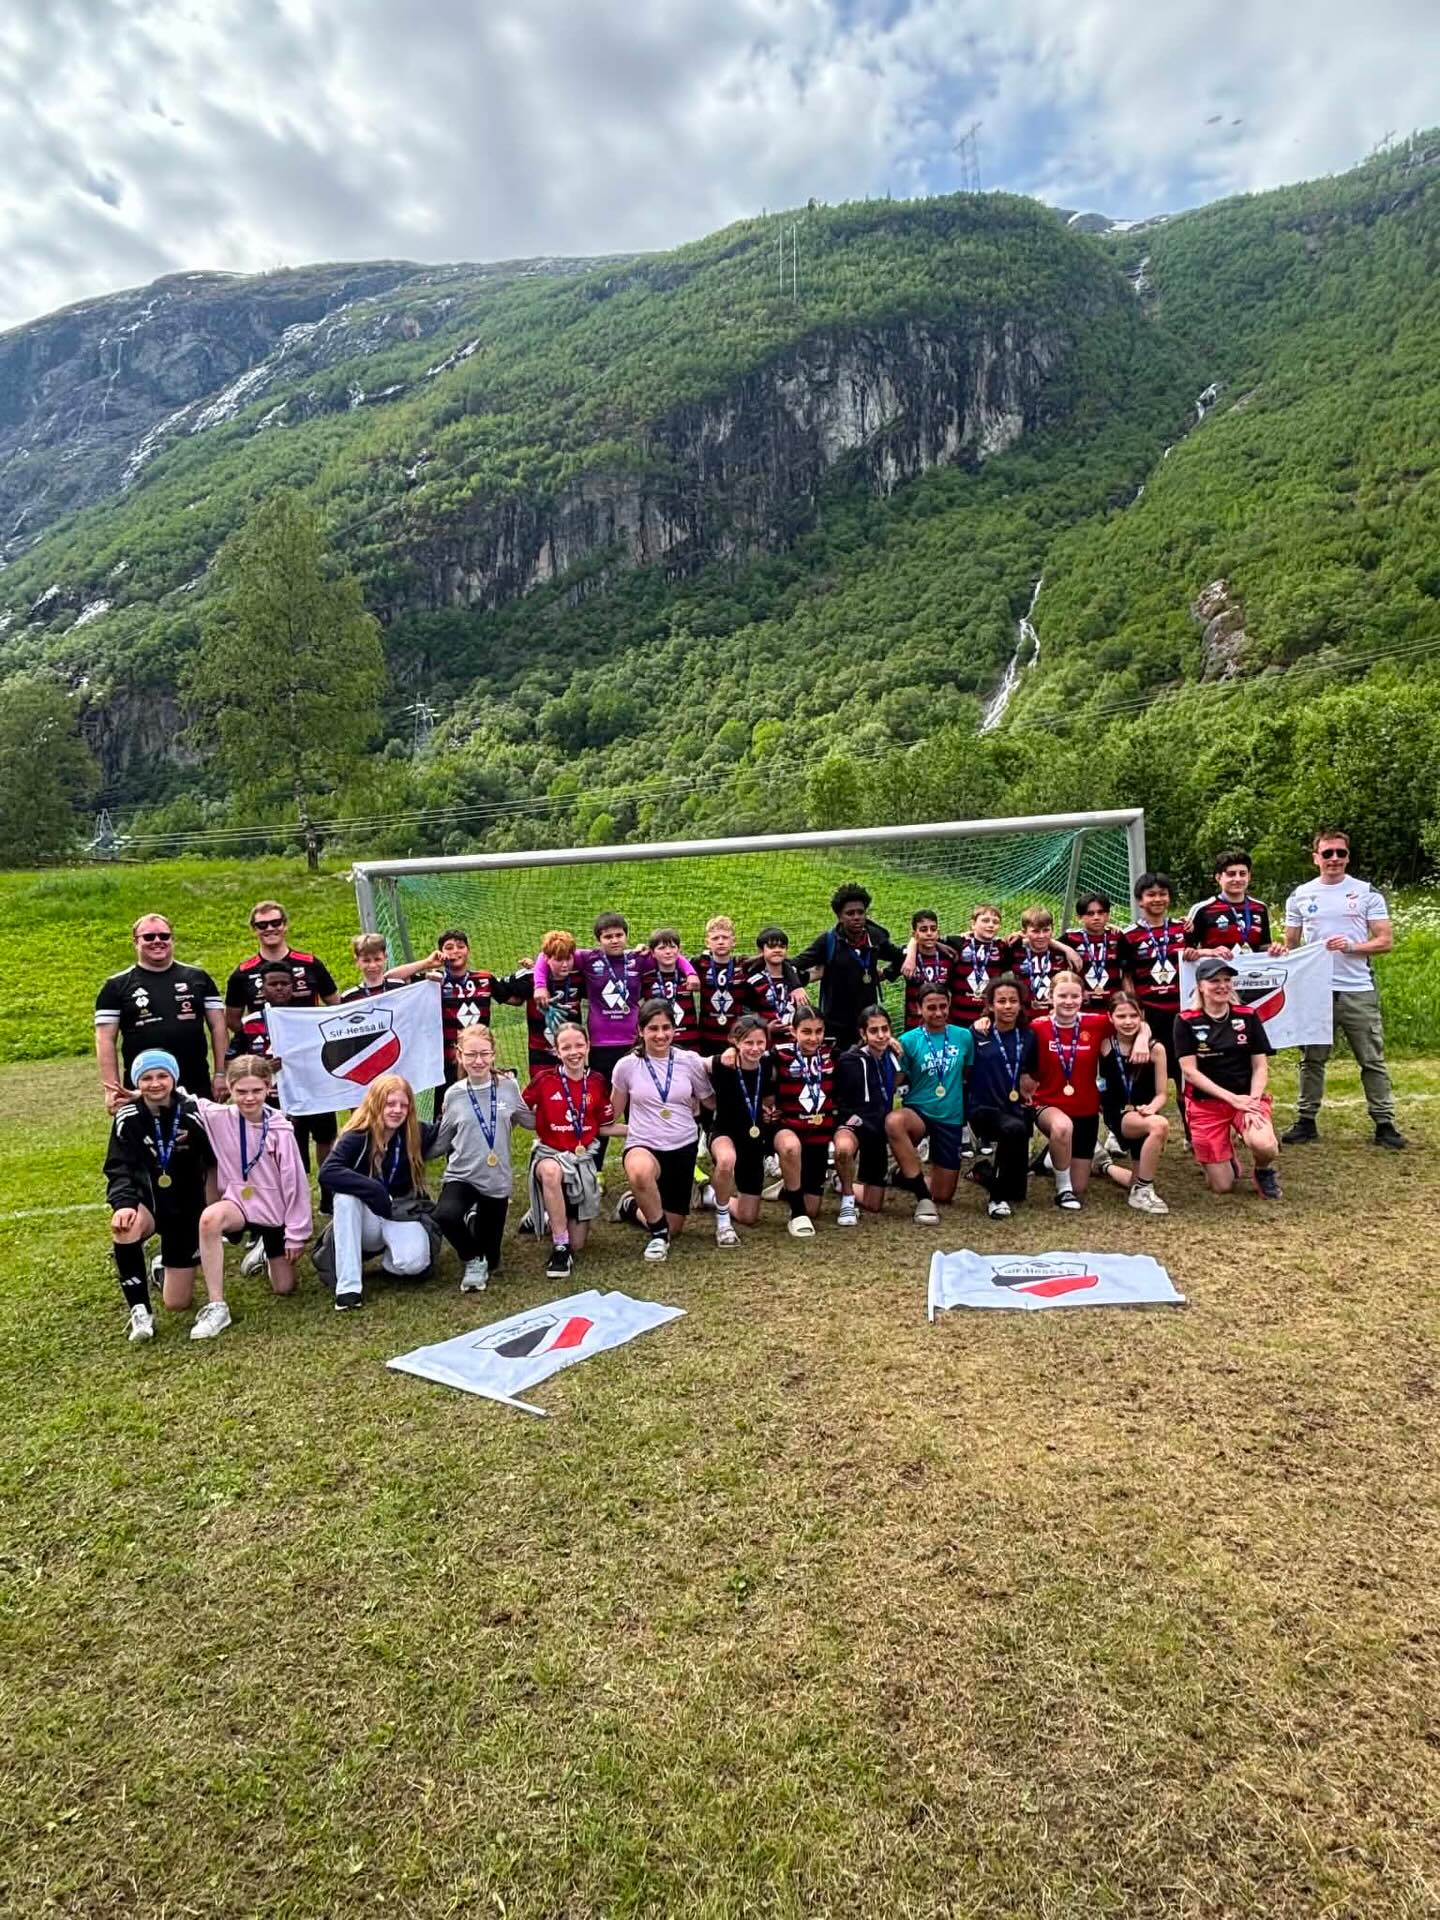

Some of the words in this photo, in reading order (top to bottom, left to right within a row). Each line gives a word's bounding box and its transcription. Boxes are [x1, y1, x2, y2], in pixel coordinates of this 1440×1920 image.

[717, 968, 727, 987] 6
[455, 980, 476, 998] 19
[664, 980, 674, 999] 3
